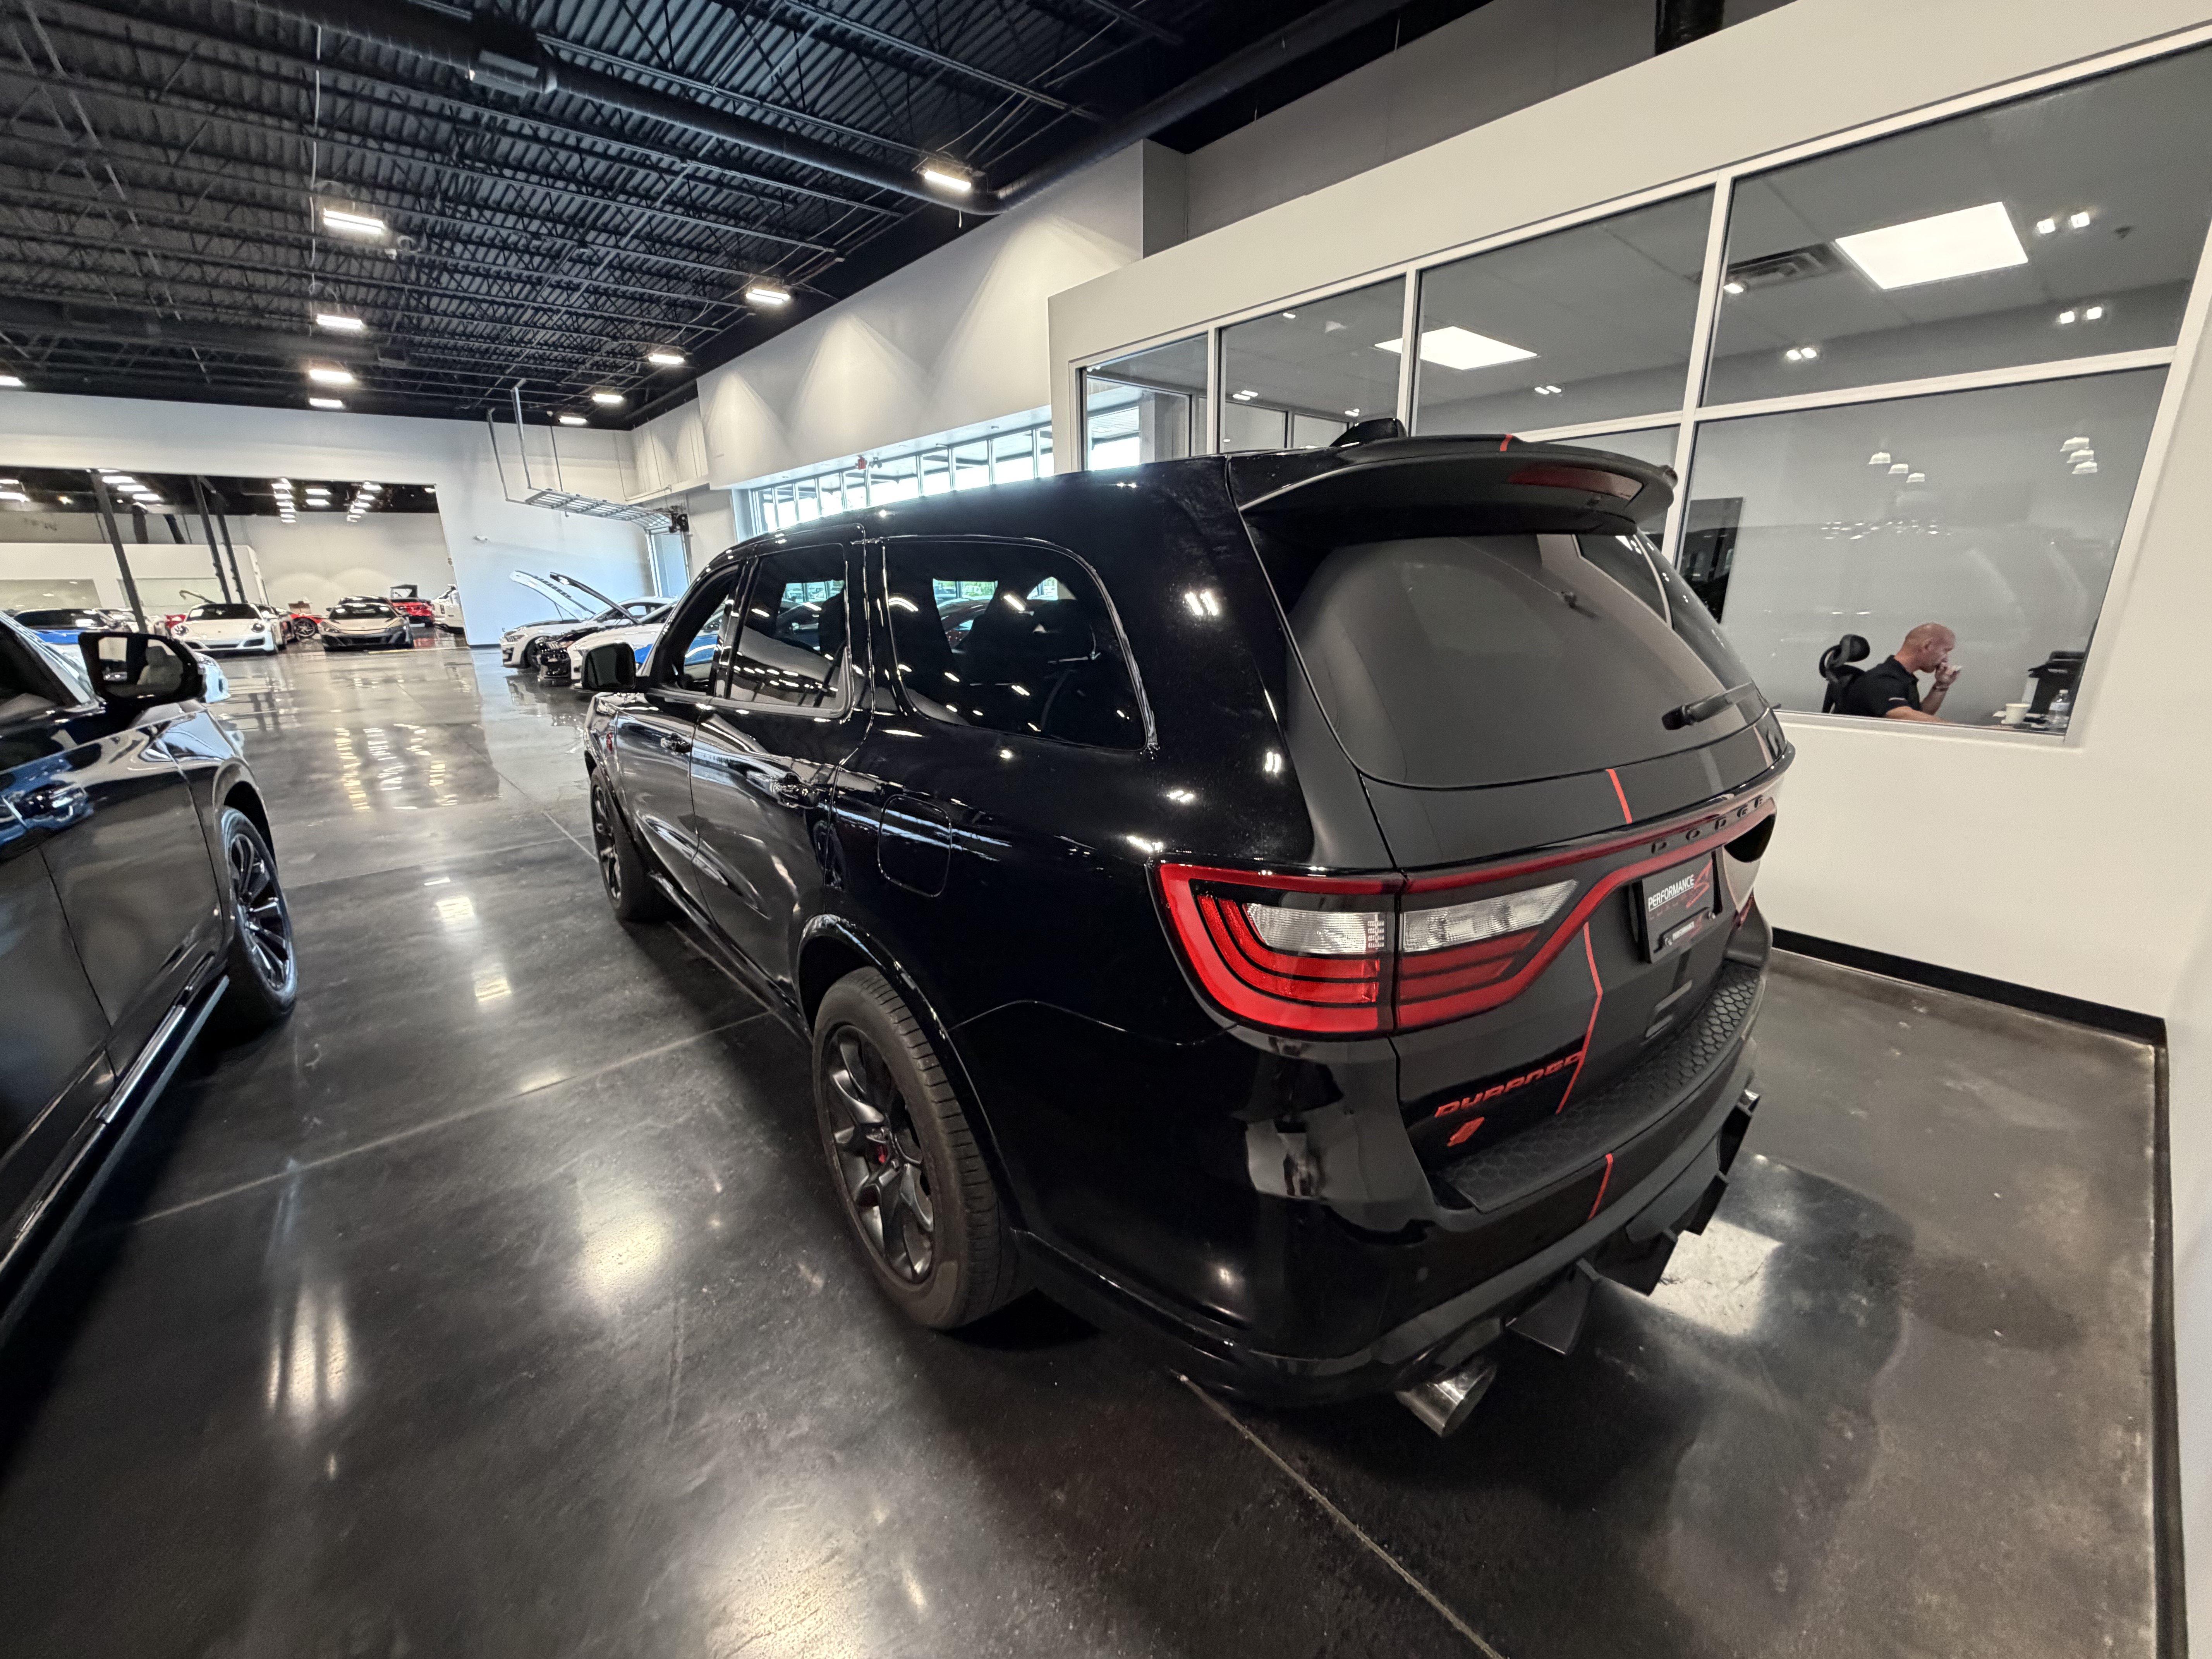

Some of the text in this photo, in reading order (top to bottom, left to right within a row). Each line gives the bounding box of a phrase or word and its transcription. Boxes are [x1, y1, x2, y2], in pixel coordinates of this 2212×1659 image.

[1650, 794, 1764, 854] DODGE
[1648, 874, 1695, 912] PERFORMANCE
[1434, 1050, 1584, 1118] DURANGO
